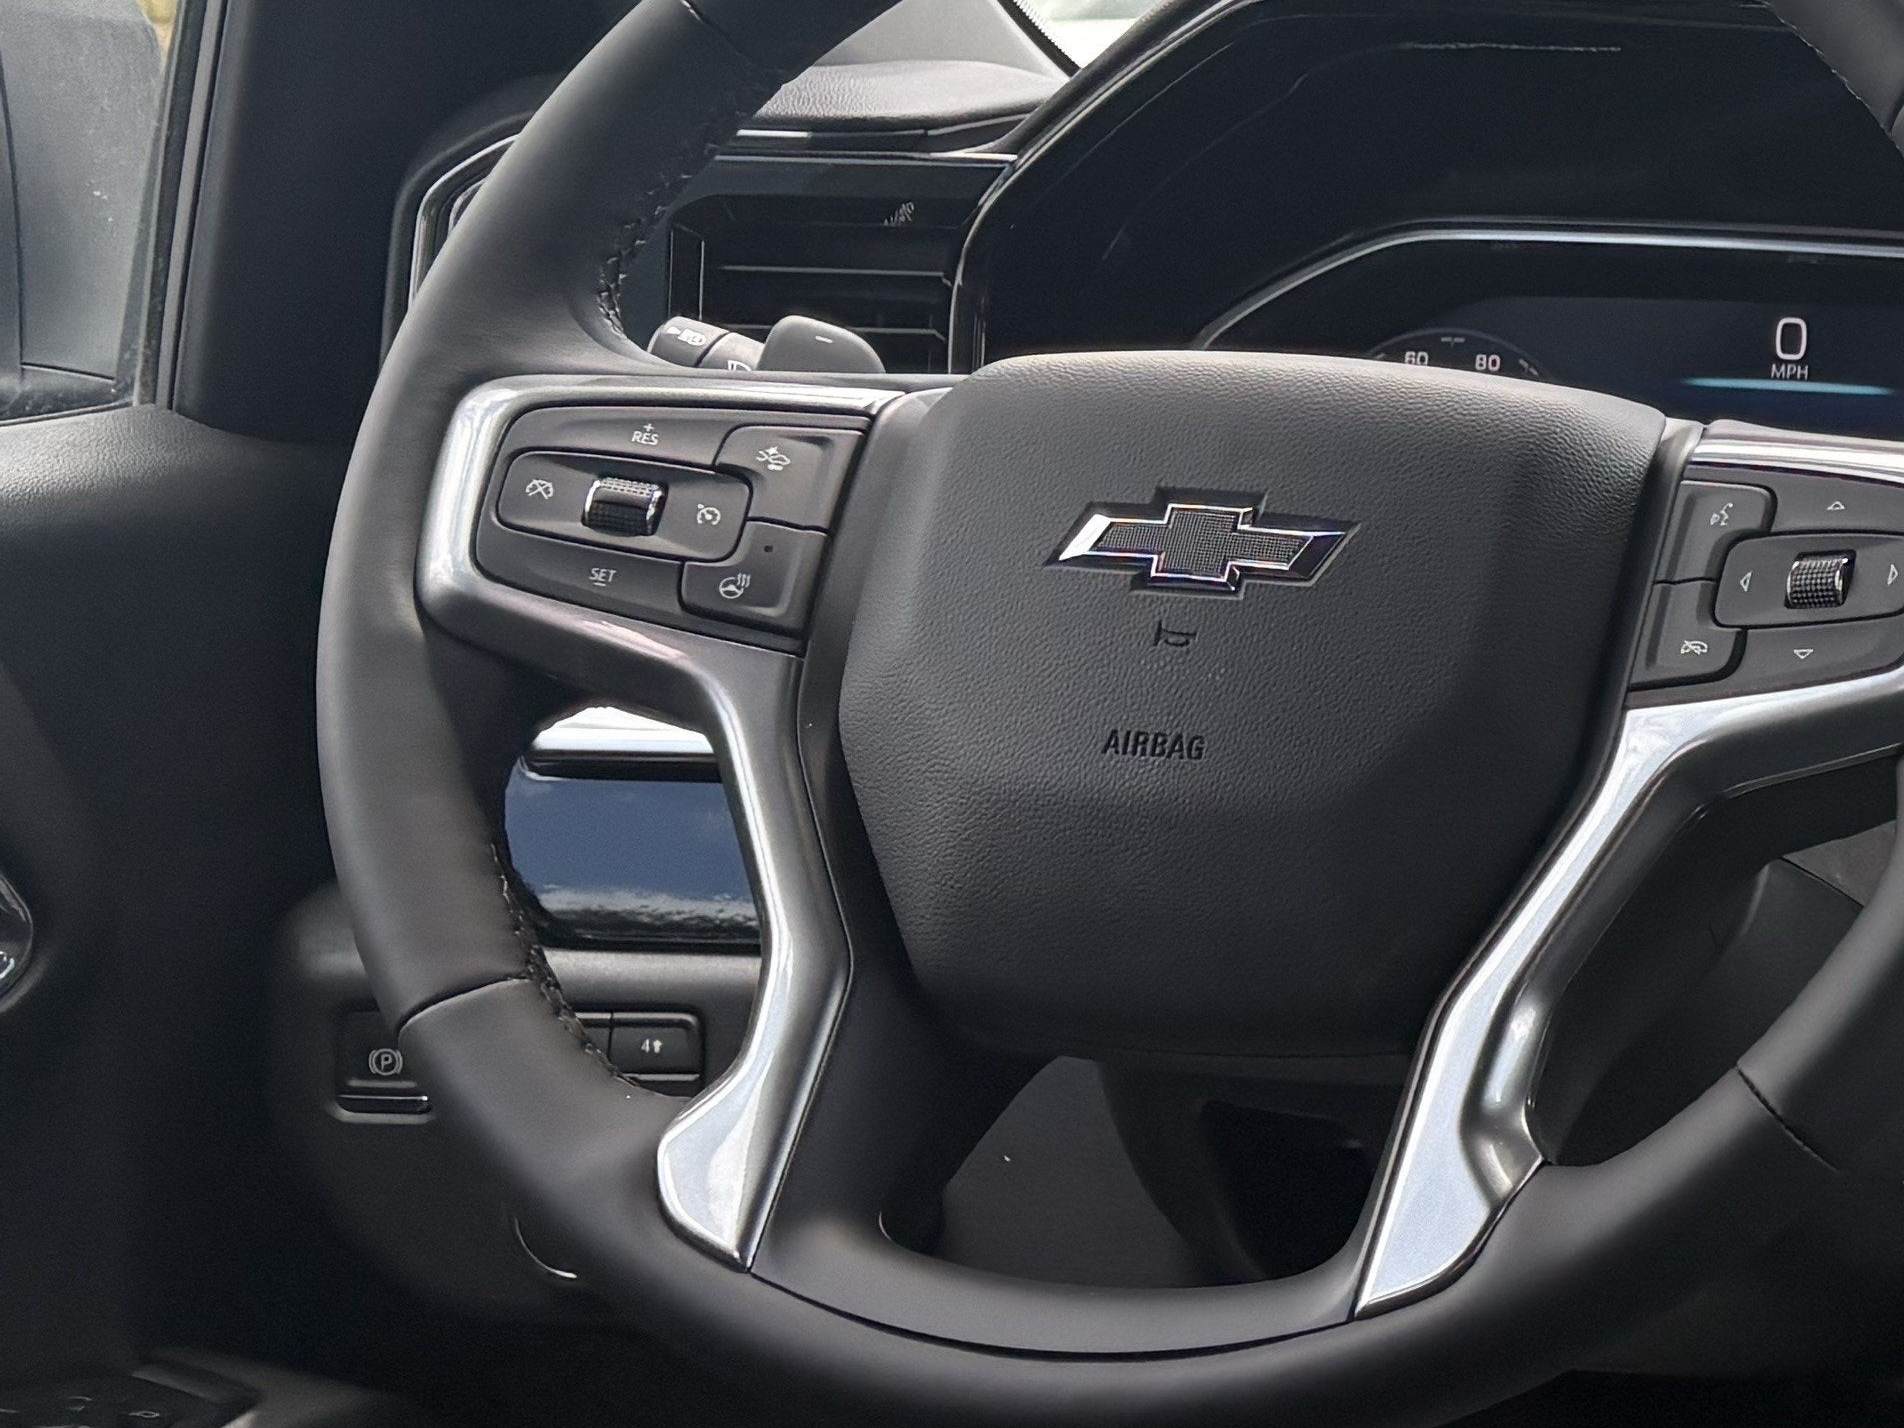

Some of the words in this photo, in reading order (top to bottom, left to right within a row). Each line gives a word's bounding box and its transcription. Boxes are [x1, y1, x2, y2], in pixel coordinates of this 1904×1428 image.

[1775, 317, 1807, 360] 0
[1475, 354, 1501, 371] 80
[1771, 364, 1808, 380] MPH
[632, 431, 659, 445] RES
[589, 569, 617, 583] SET
[1102, 728, 1205, 761] AIRBAG
